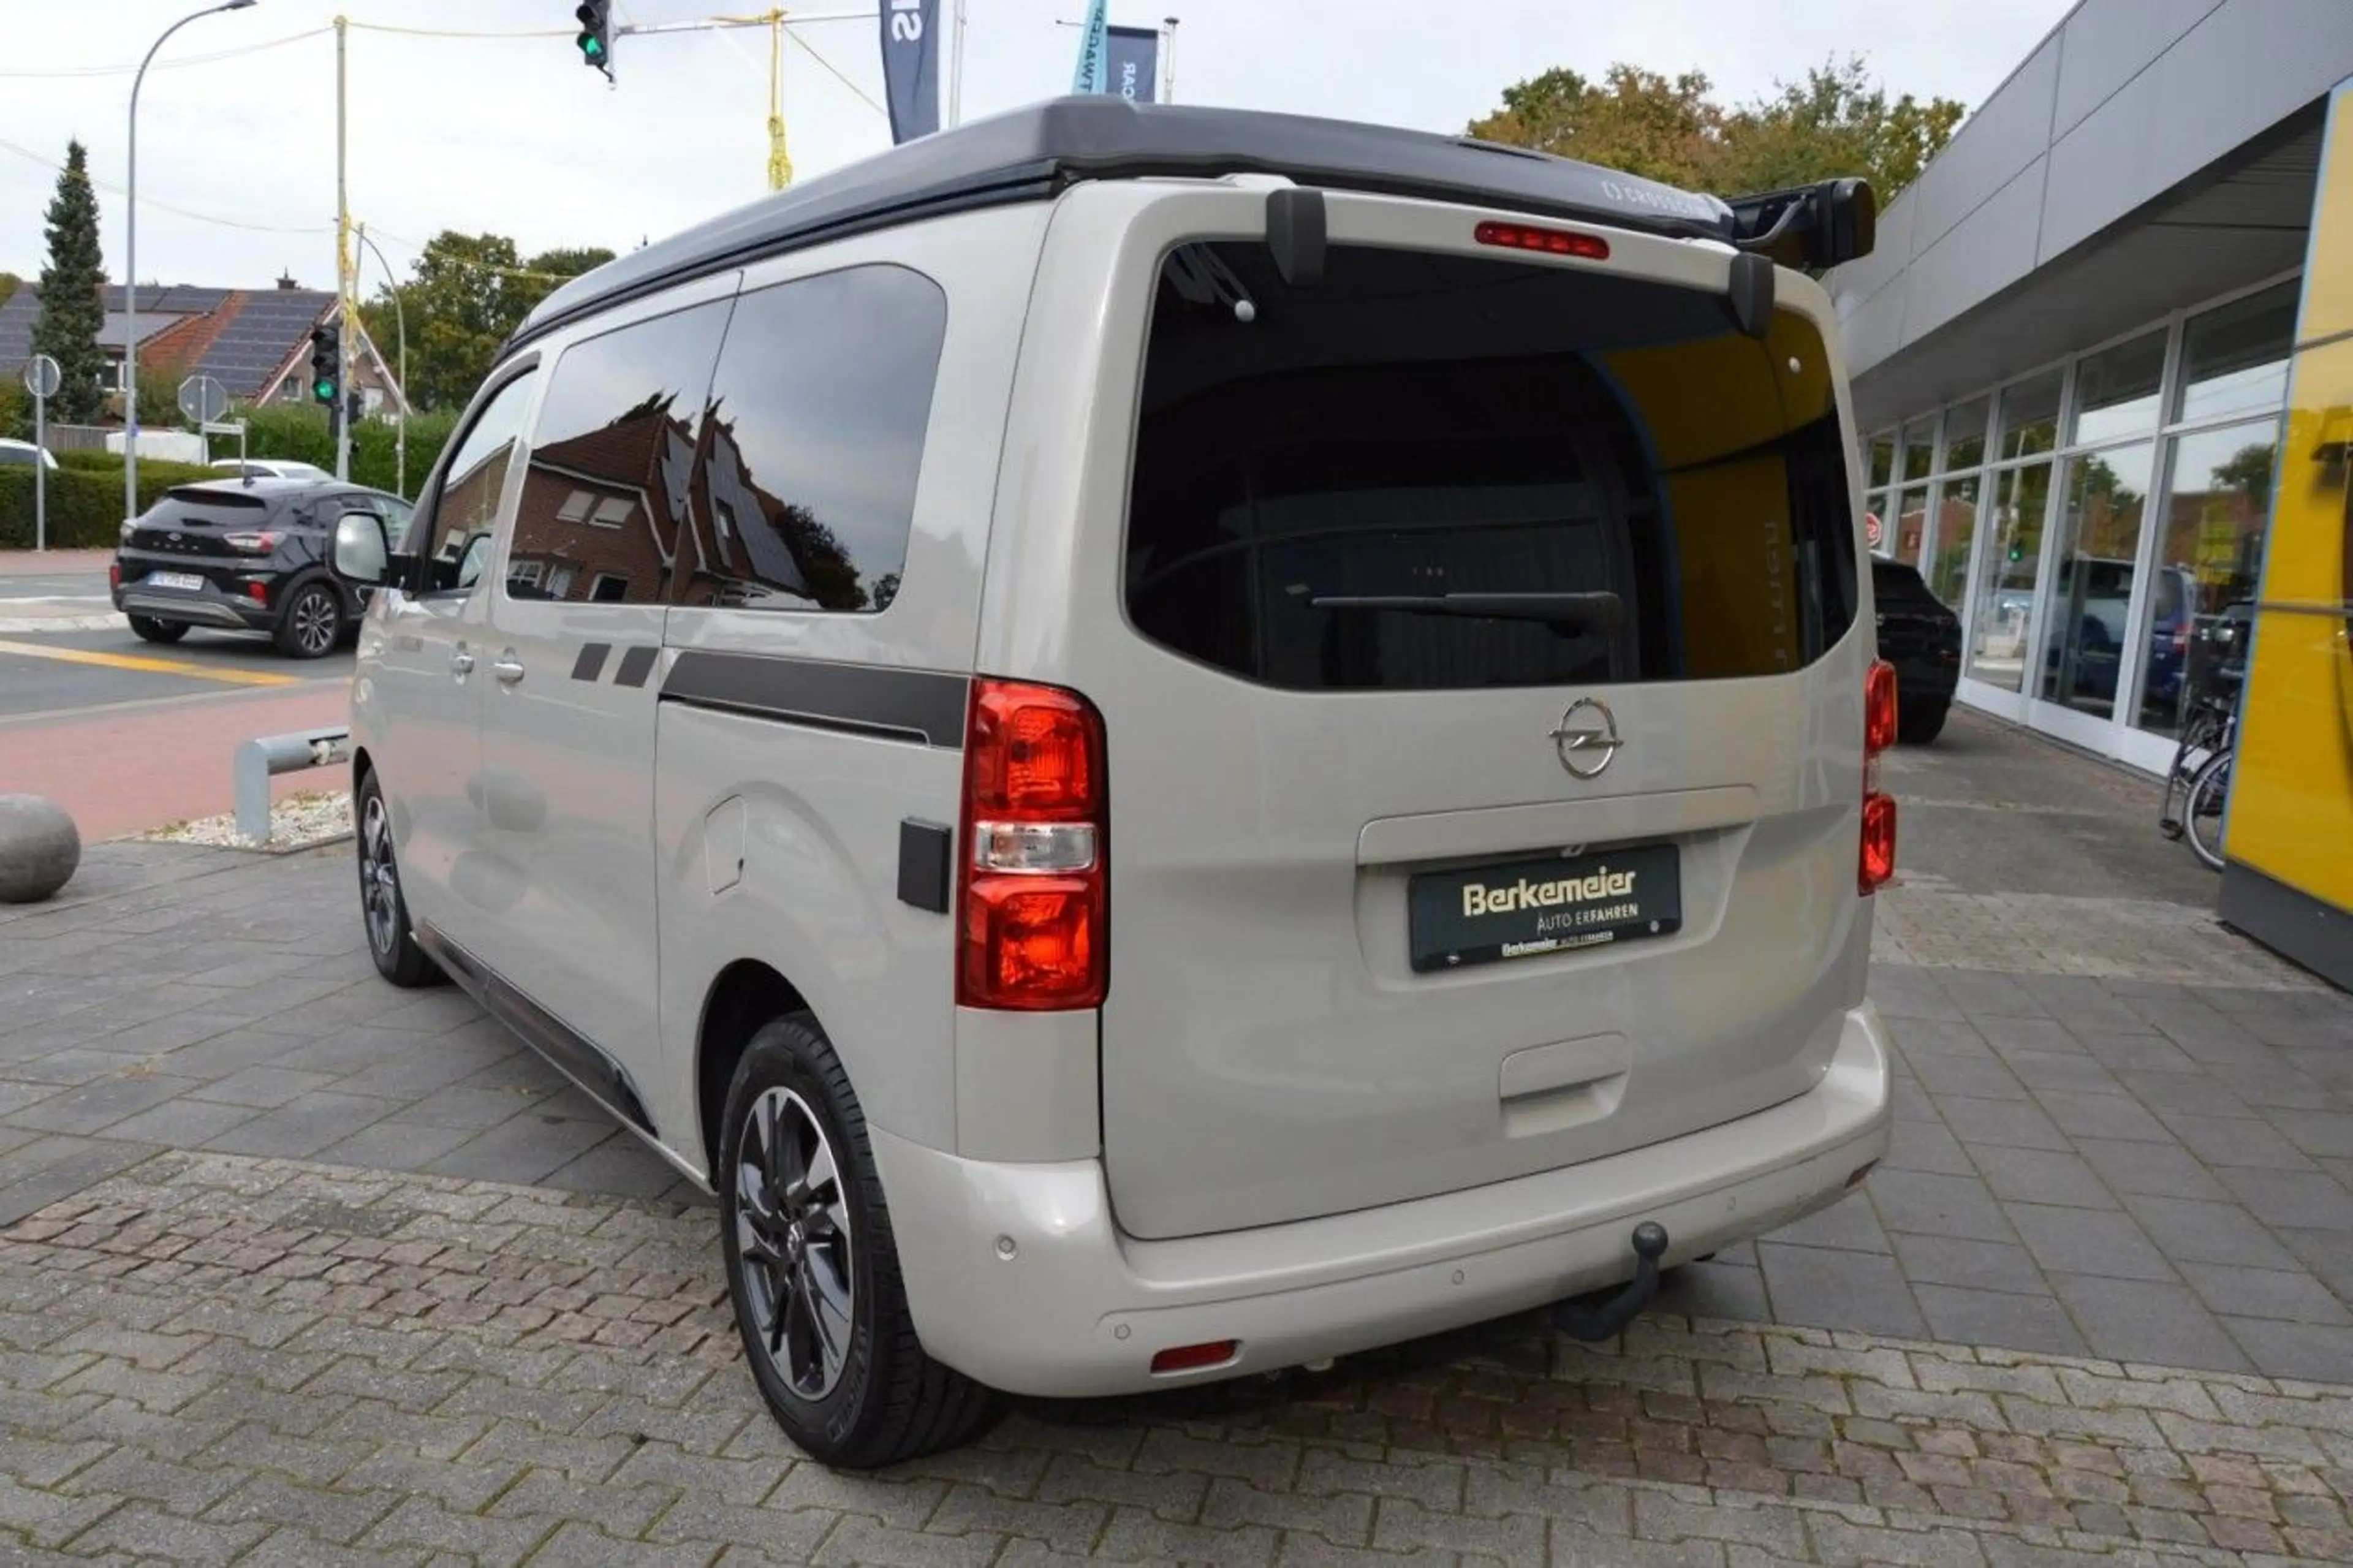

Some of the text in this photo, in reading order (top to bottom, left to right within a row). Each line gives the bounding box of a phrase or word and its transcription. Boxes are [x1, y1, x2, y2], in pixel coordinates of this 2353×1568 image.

[1463, 865, 1637, 917] Berkemeier
[1536, 903, 1640, 935] AUTO ERFAHREN
